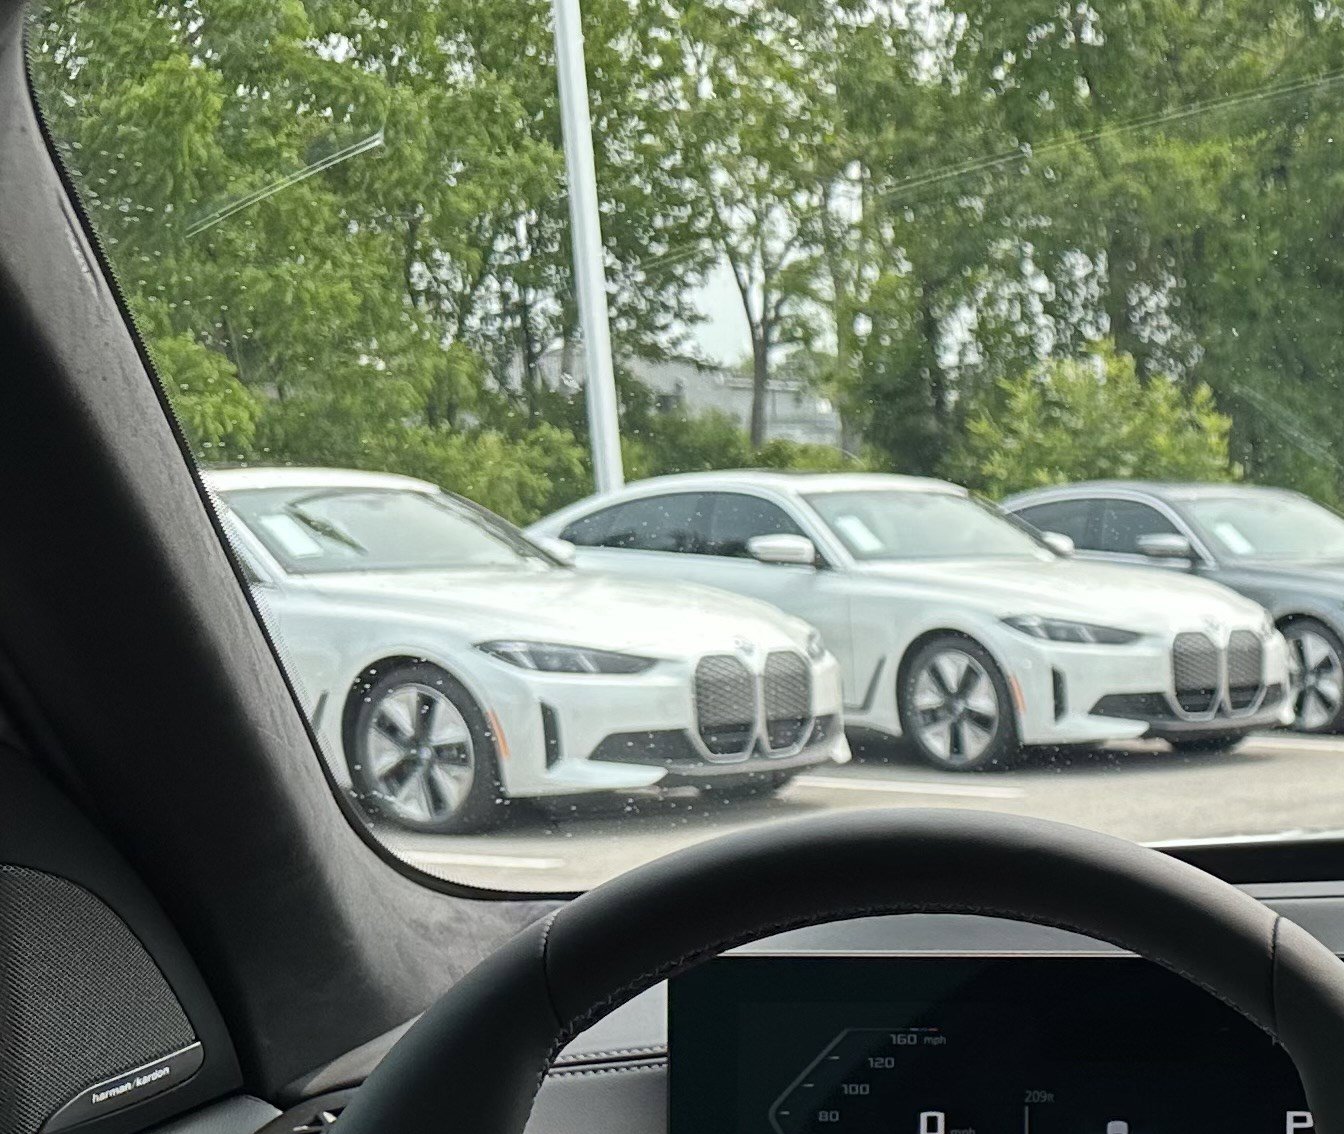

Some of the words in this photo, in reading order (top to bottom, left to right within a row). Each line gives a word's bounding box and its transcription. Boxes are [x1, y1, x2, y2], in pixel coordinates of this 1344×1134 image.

[890, 1034, 917, 1046] 160
[924, 1035, 947, 1046] mph
[868, 1057, 895, 1069] 120
[92, 1066, 170, 1104] harman/kardon
[842, 1084, 870, 1096] 100
[818, 1110, 840, 1122] 80
